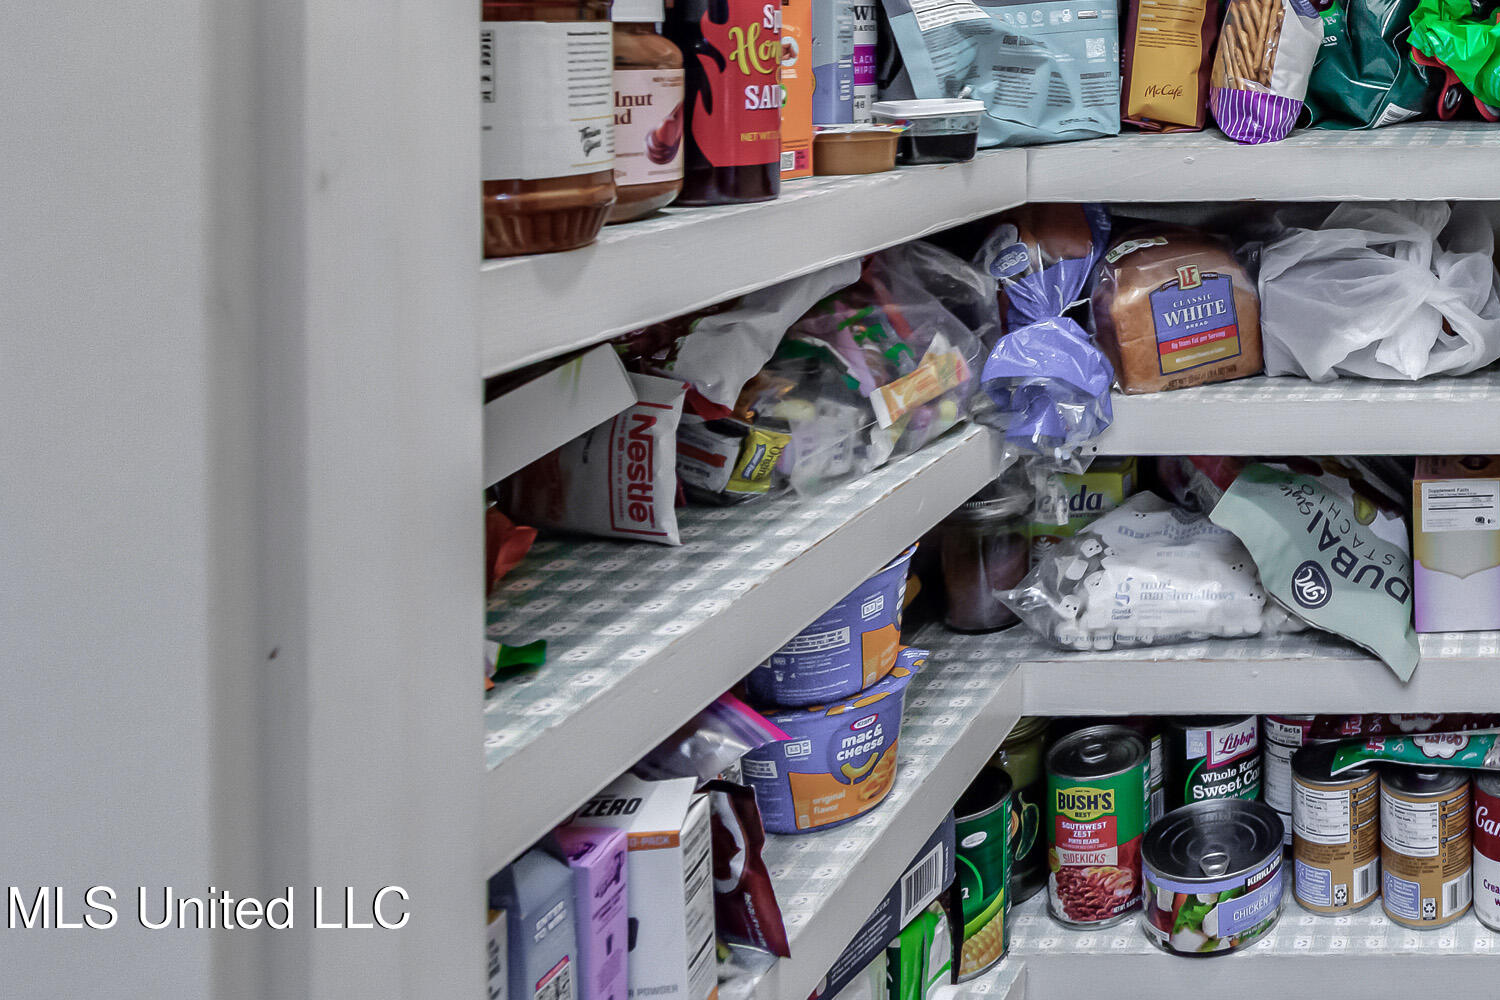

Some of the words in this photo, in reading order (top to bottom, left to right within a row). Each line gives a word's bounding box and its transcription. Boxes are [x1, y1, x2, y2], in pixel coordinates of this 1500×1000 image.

[1173, 294, 1212, 308] CLASSIC
[1162, 299, 1227, 328] WHITE
[1185, 320, 1209, 330] BREAD
[1306, 509, 1412, 606] DUBAI
[841, 729, 873, 748] mac
[873, 724, 883, 736] &
[1201, 765, 1237, 784] Whole
[1193, 776, 1242, 800] Sweet
[580, 798, 642, 818] ZERO
[1058, 790, 1113, 811] BUSH'S
[1062, 821, 1107, 830] SOUTHWEST
[1073, 830, 1091, 838] ZEST
[1062, 853, 1107, 864] SIDEKICKS
[1247, 856, 1281, 887] KIRKLAND
[1233, 897, 1269, 921] CHICKEN
[637, 984, 678, 996] POWDER
